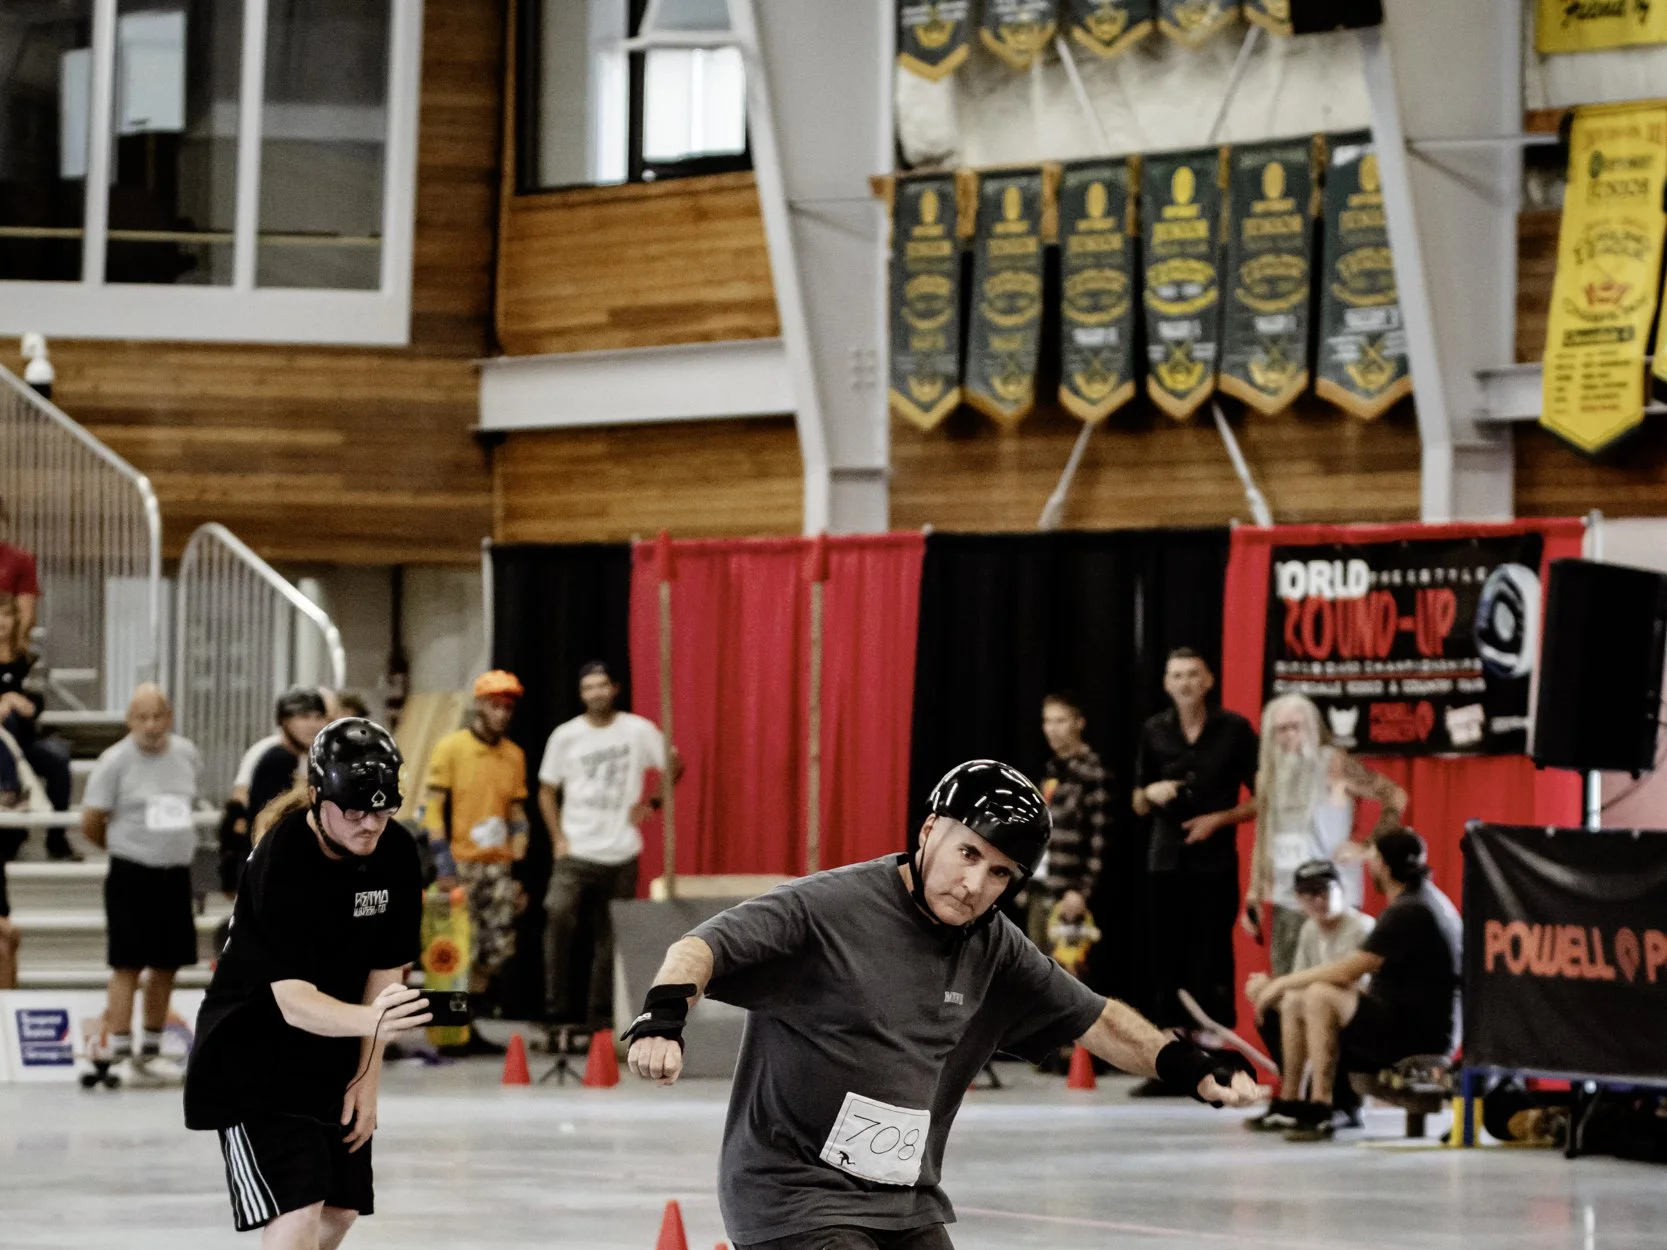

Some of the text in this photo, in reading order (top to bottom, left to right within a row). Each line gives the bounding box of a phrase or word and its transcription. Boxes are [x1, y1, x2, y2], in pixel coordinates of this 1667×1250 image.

[1274, 559, 1370, 600] ORLD
[1484, 919, 1616, 980] POWELL
[845, 1114, 920, 1161] 708
